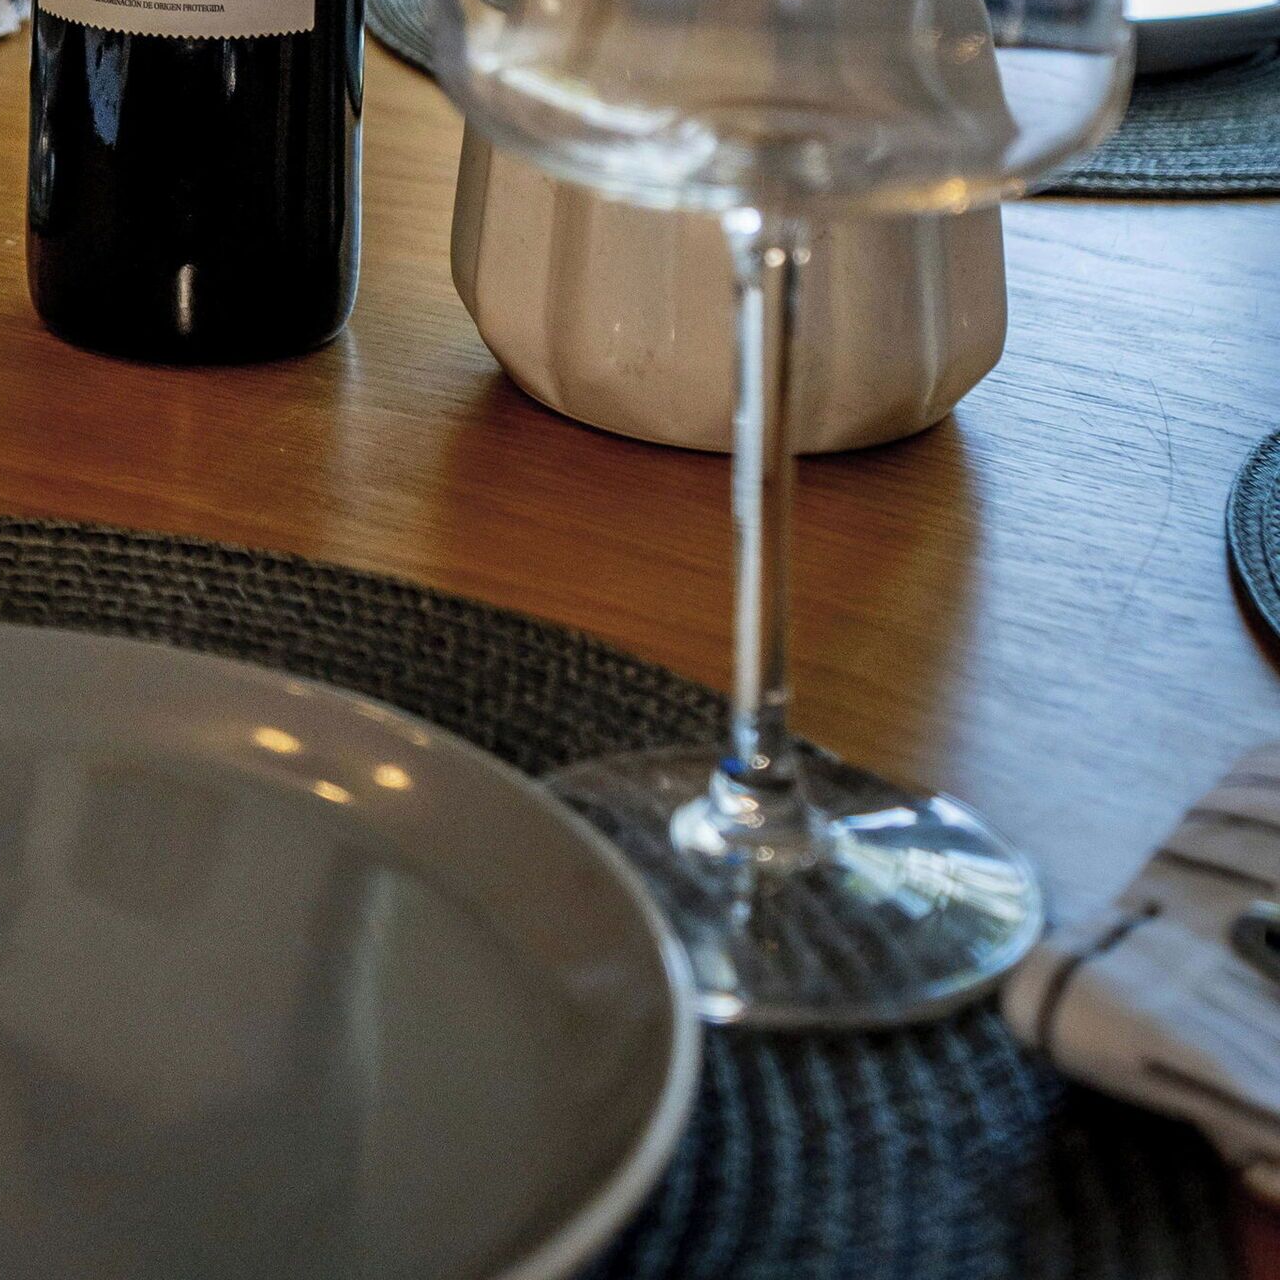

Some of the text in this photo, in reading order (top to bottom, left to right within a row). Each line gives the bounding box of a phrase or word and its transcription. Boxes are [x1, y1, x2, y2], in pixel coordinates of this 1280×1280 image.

[142, 0, 154, 10] DE
[153, 1, 181, 12] ORIGEN
[182, 2, 226, 13] PROTEGIDA
